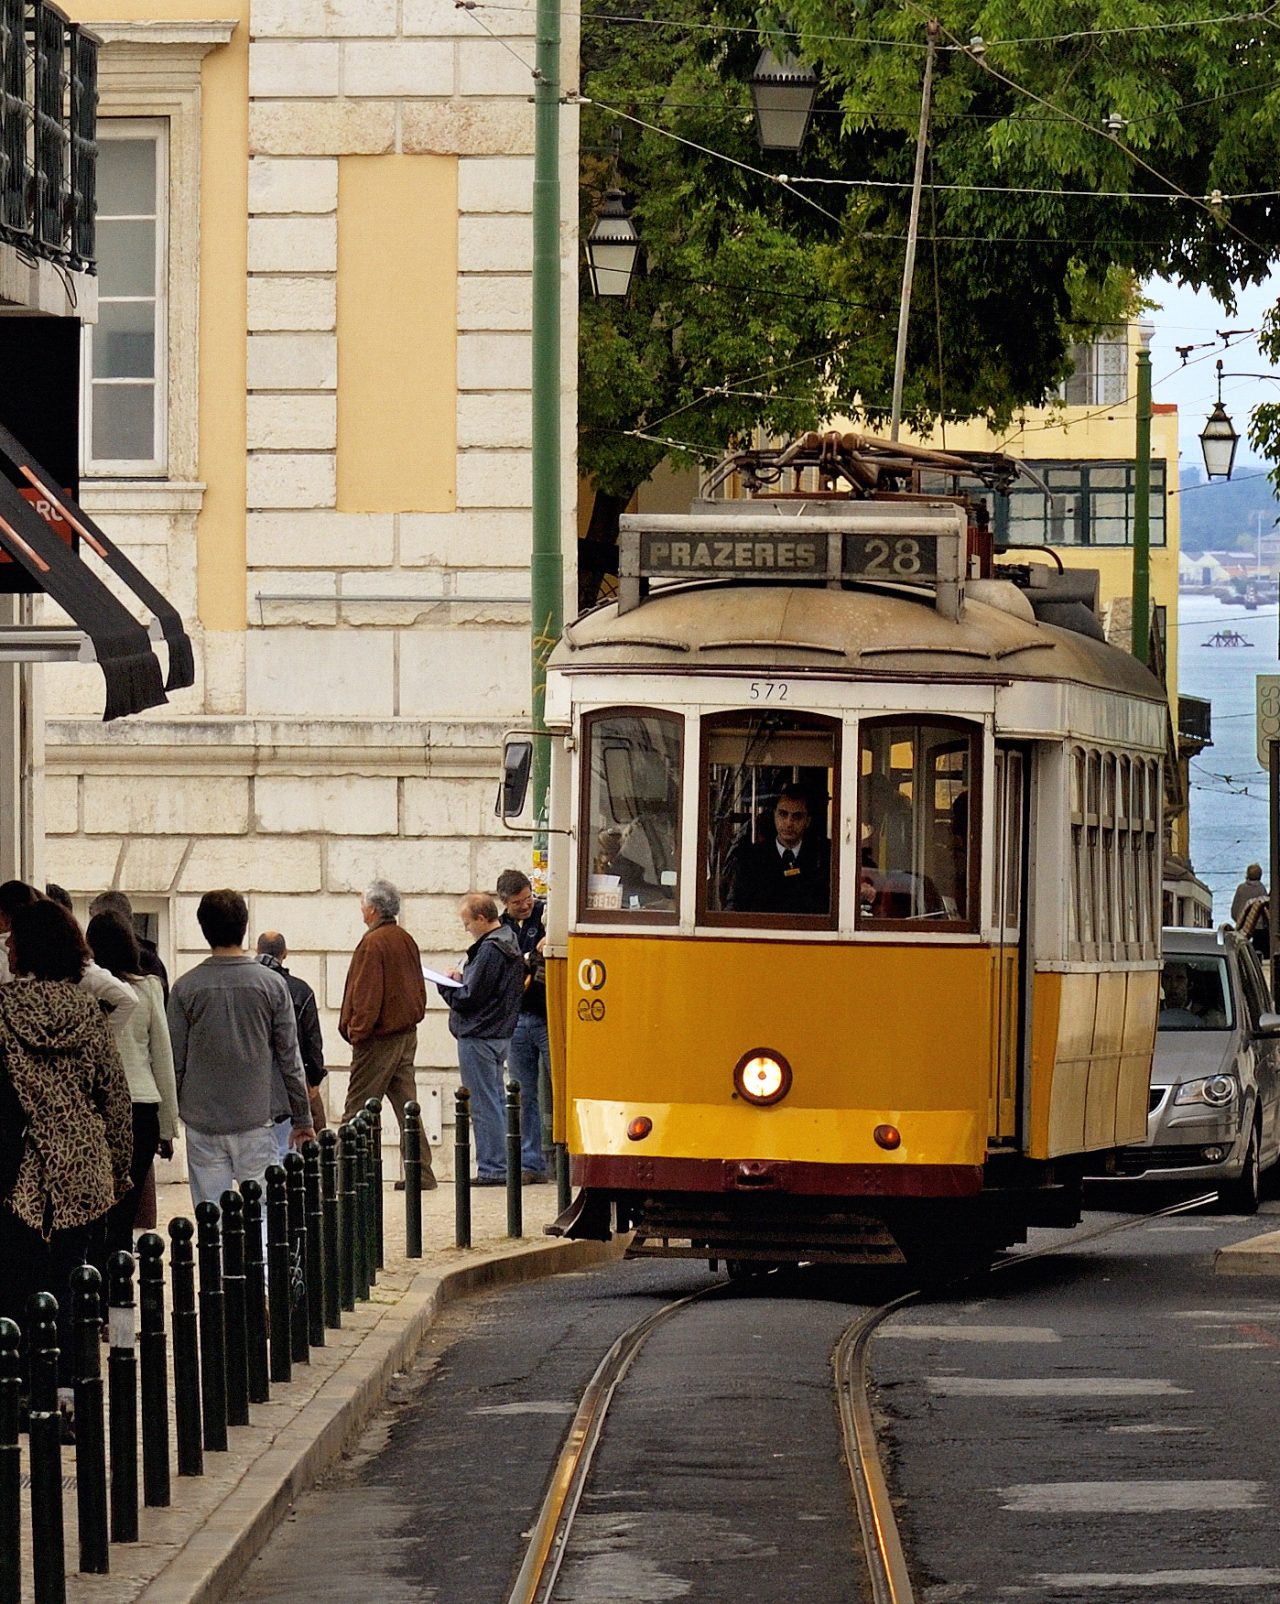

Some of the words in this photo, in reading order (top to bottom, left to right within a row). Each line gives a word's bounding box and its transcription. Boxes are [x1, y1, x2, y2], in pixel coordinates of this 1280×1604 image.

[649, 541, 816, 568] PRAZERES
[864, 538, 921, 575] 28
[749, 682, 789, 702] 572
